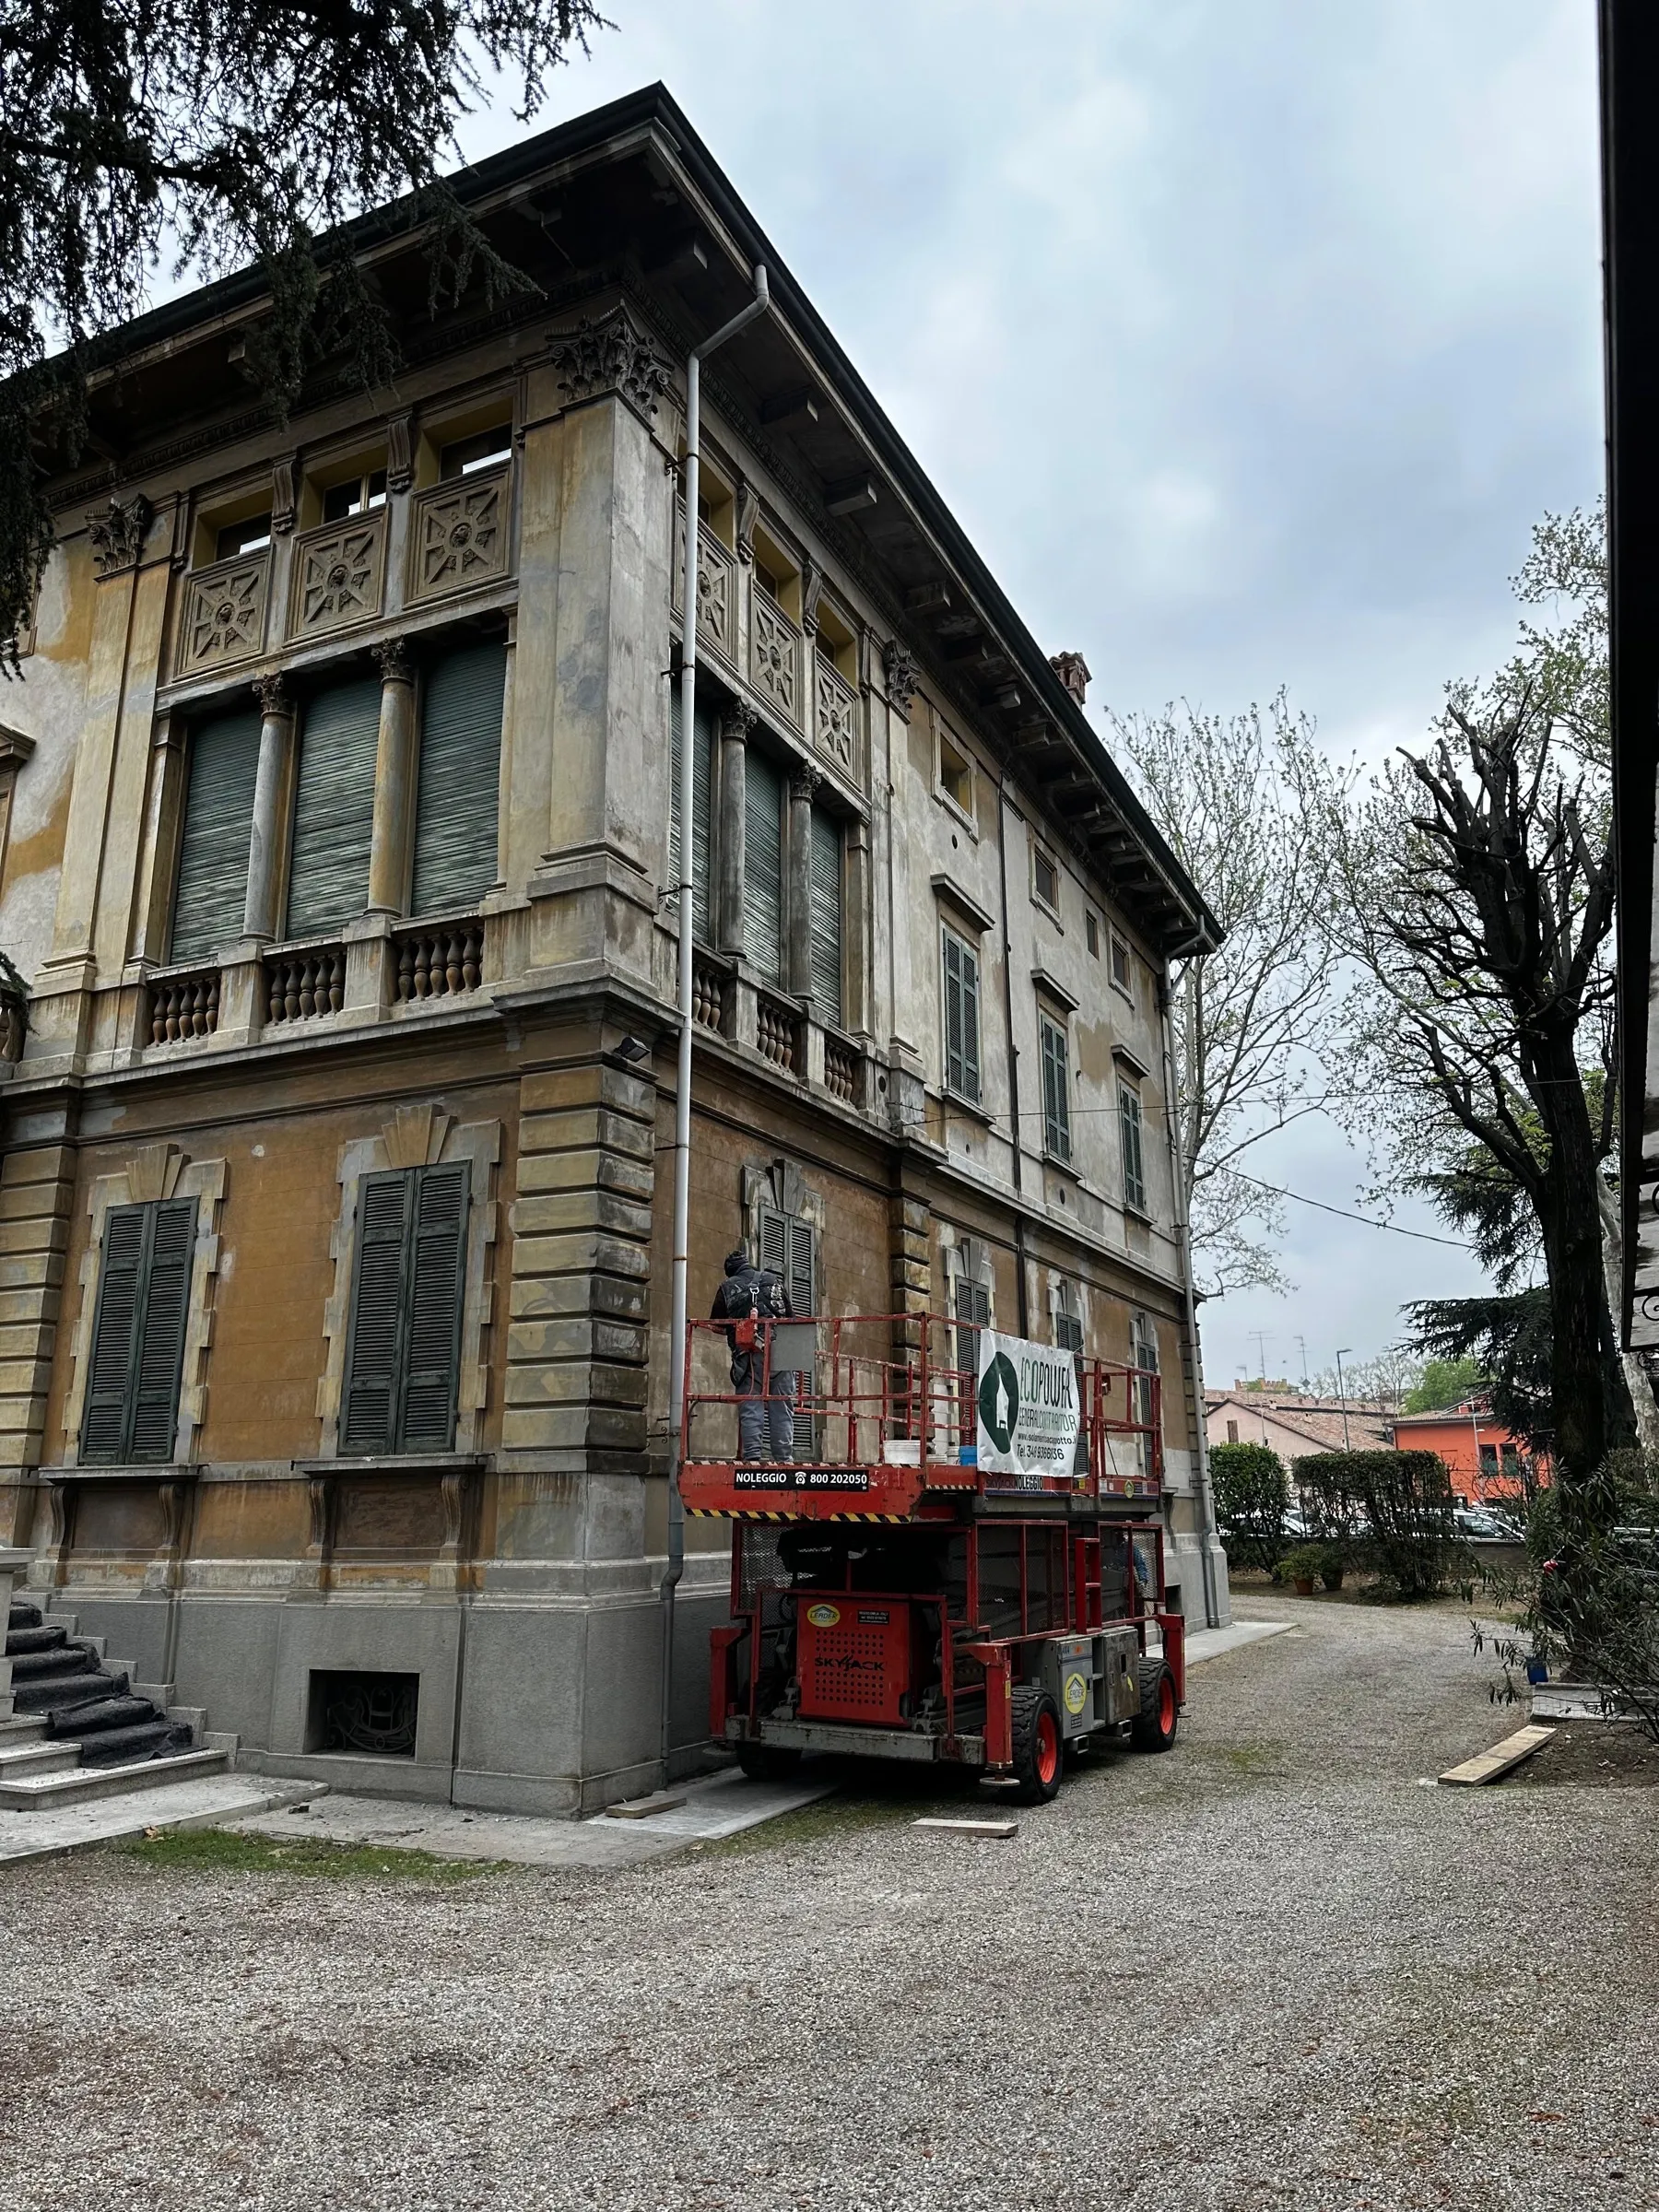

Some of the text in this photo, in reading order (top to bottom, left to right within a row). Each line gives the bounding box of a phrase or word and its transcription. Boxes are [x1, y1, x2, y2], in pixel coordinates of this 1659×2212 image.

[735, 1473, 867, 1485] NOLEGGIO 800 202050
[1015, 1476, 1043, 1490] NOLEGGIO
[815, 1653, 886, 1672] SKYJACK
[1067, 1688, 1084, 1699] LEADER
